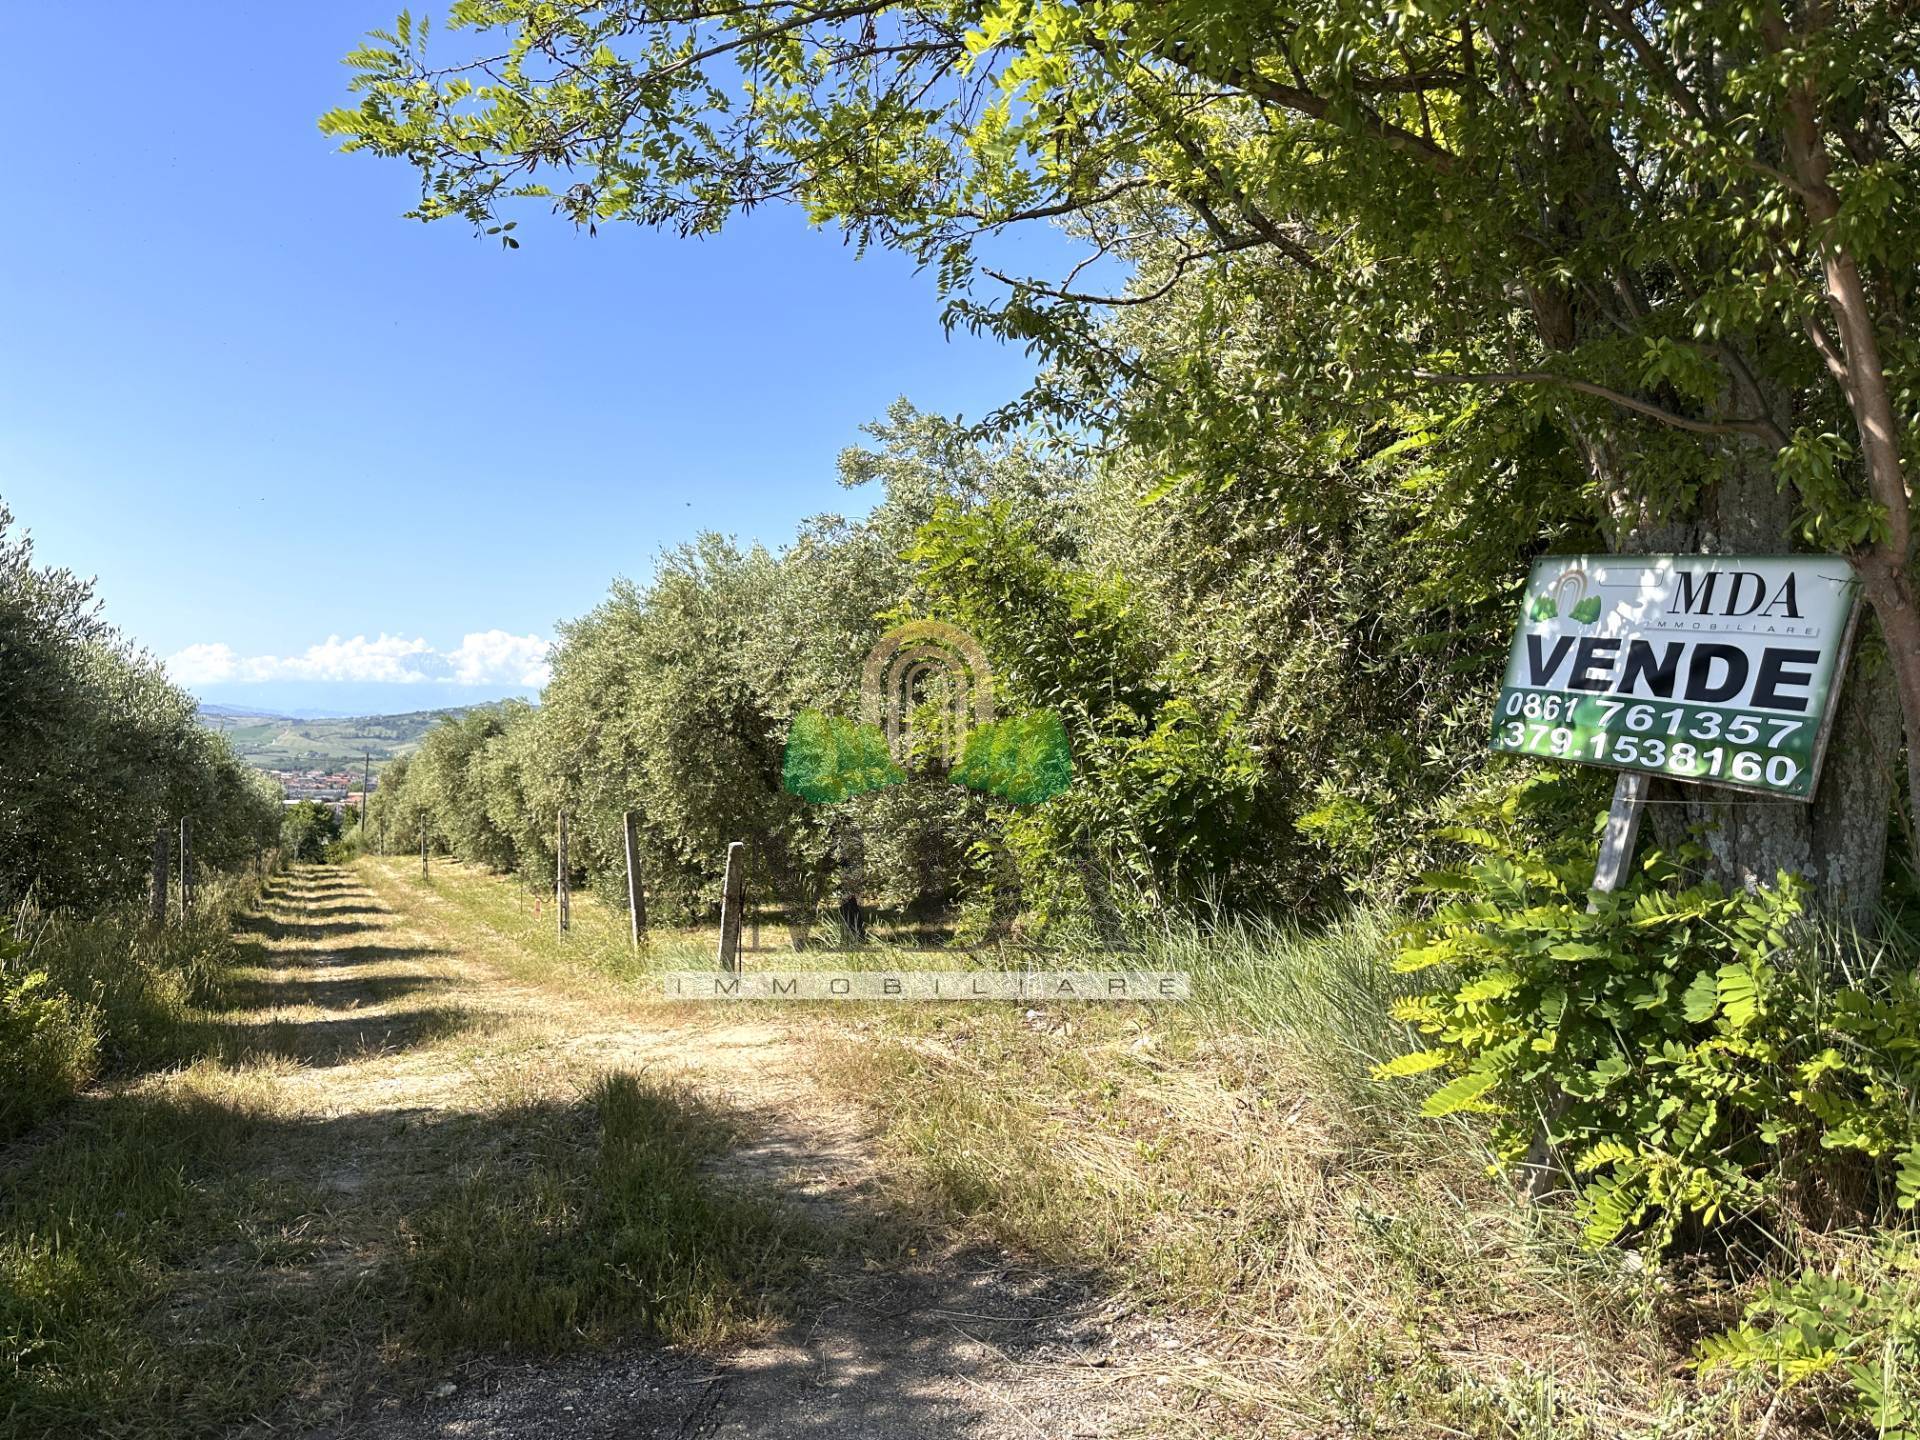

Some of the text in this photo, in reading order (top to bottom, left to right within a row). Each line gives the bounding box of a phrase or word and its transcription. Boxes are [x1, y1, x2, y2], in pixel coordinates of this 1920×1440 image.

[1666, 571, 1805, 619] MDA
[1646, 620, 1815, 636] IMMOBILIARE
[1526, 633, 1821, 712] VENDE
[1505, 691, 1804, 749] 0861 761357
[1503, 721, 1799, 786] 379.1538160
